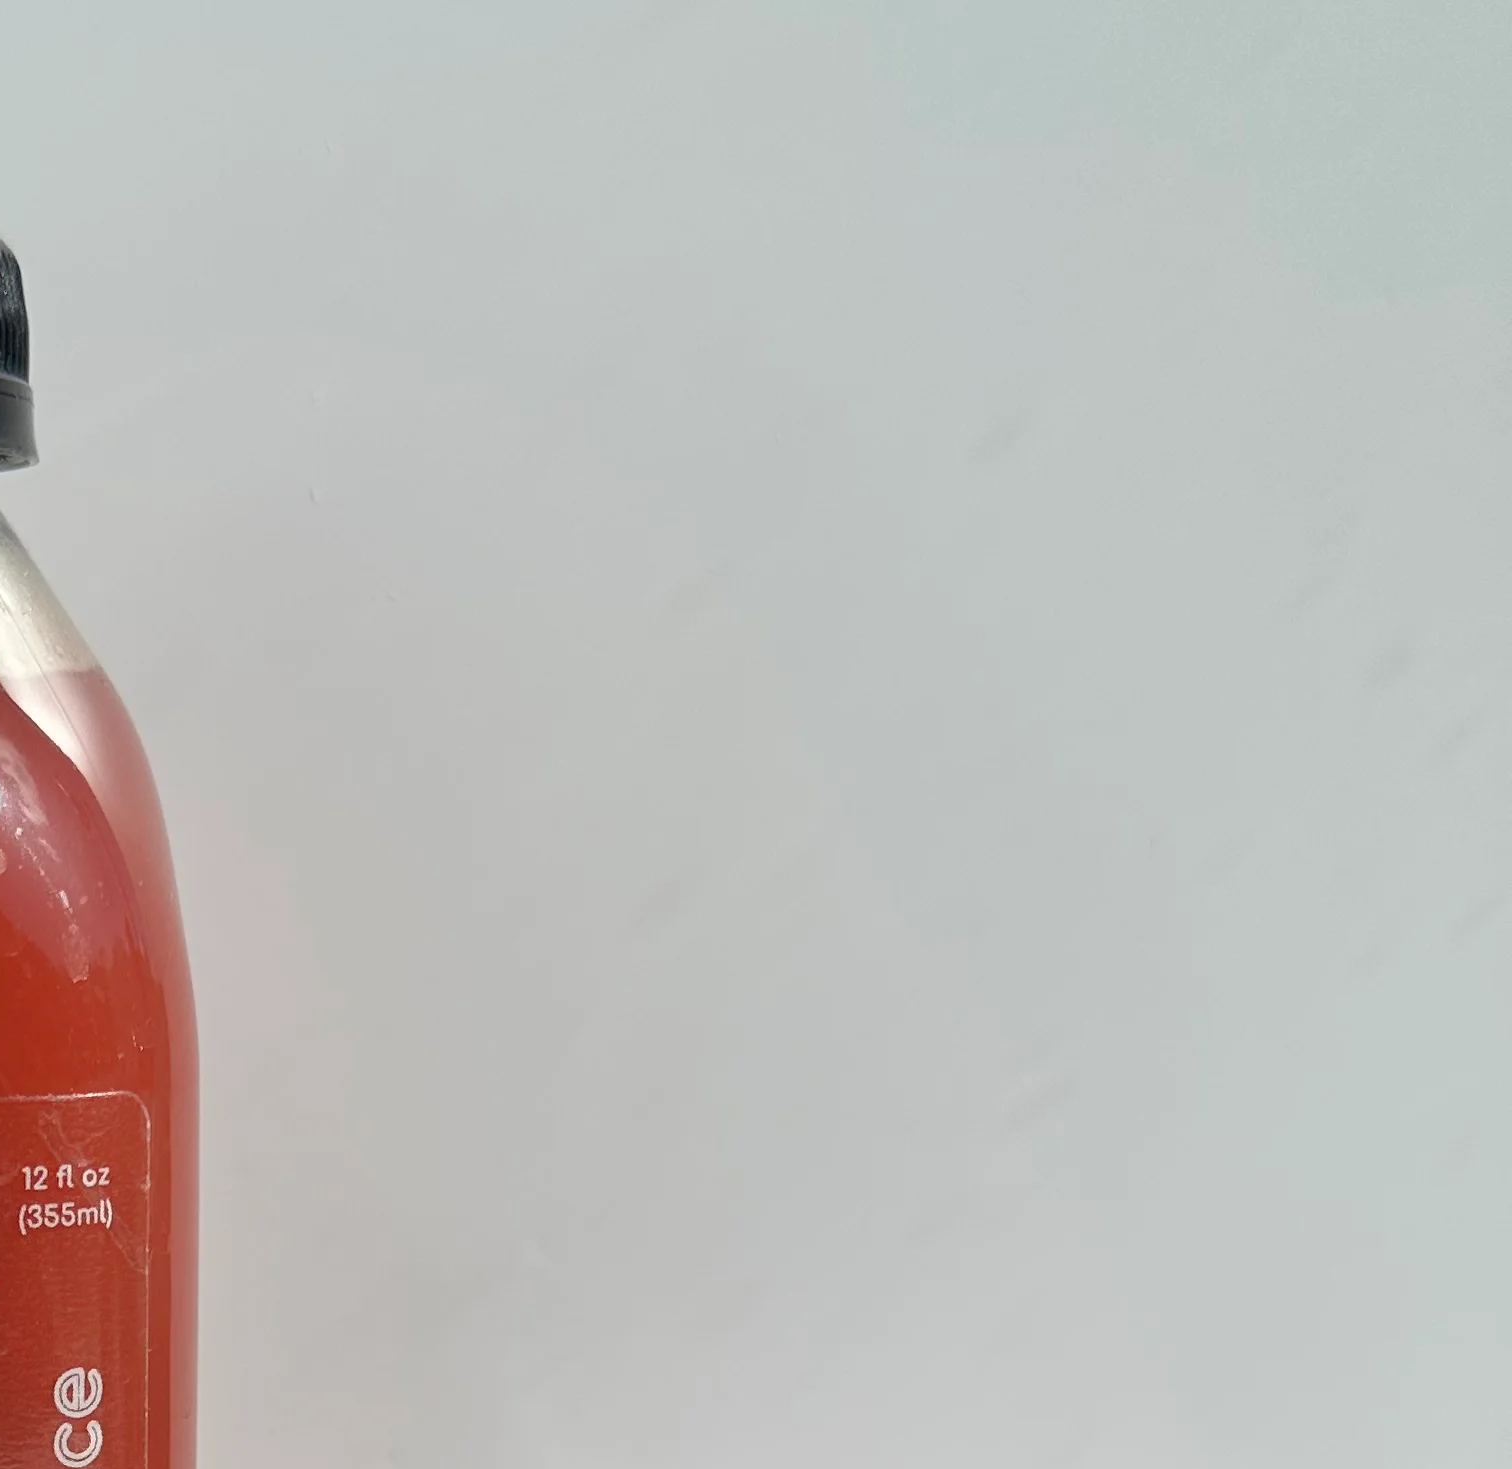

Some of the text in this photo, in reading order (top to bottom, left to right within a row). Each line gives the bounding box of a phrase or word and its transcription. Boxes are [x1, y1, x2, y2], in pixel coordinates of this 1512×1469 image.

[21, 1163, 110, 1191] 12 fl oz
[18, 1198, 113, 1236] (355ml)
